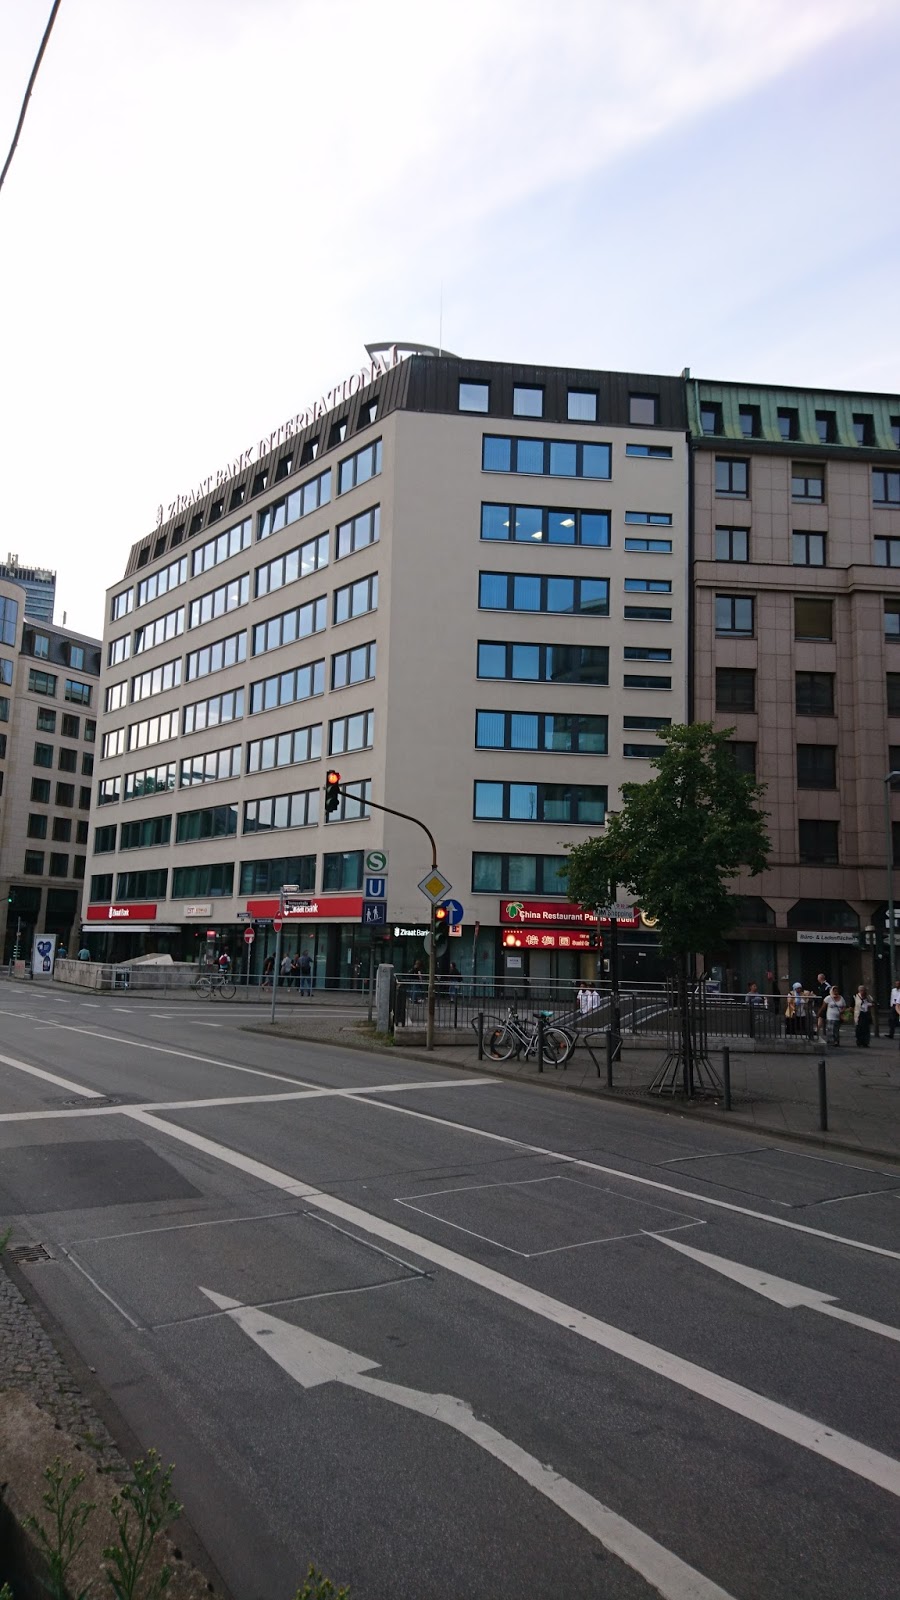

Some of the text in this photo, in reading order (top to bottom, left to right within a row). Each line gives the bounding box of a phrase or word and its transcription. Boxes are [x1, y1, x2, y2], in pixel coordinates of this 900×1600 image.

[217, 446, 254, 487] BANK
[257, 343, 403, 458] INTERNATIONAL
[369, 852, 384, 871] S
[369, 879, 382, 897] U
[520, 911, 541, 920] China
[542, 911, 584, 921] Restaurant
[585, 913, 606, 922] Pals
[400, 928, 416, 936] Ziraat
